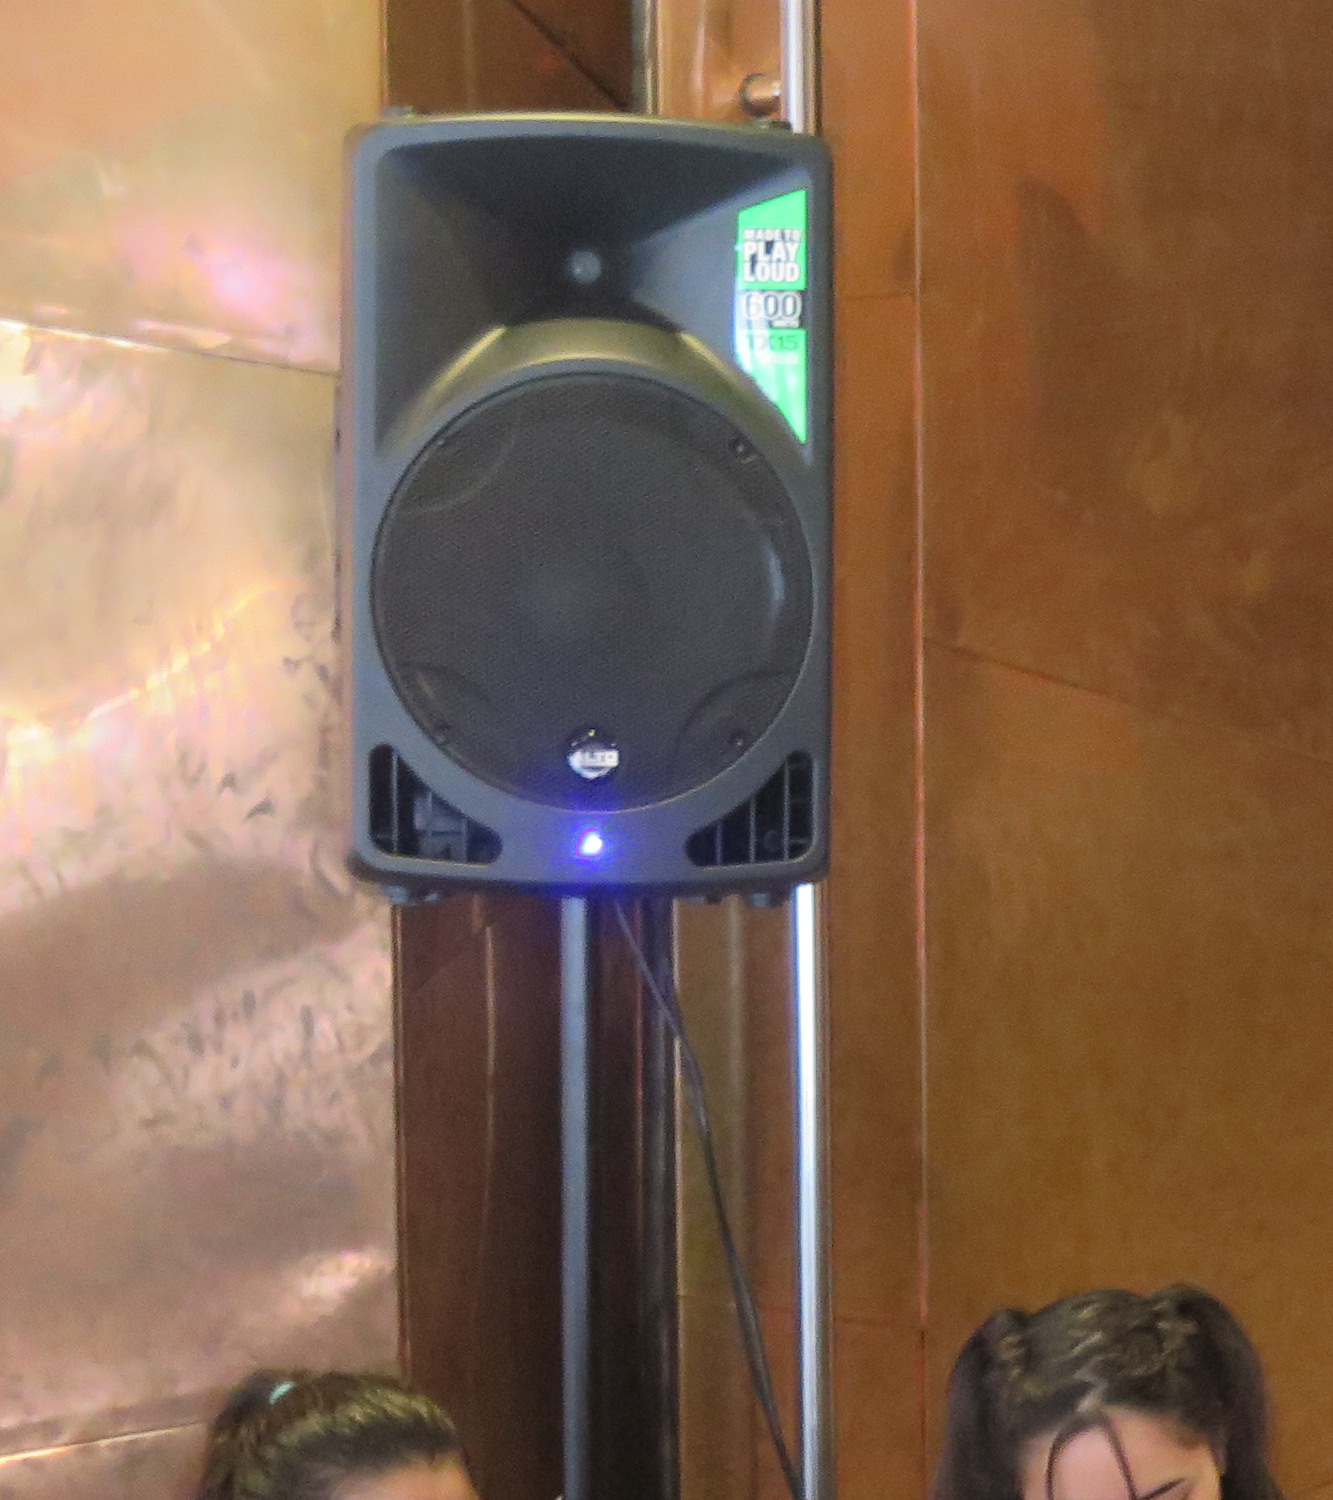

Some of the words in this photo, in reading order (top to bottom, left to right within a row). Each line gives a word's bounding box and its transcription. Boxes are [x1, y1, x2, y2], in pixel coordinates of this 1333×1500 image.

[743, 241, 800, 261] PLAY
[743, 262, 801, 282] LOUD
[741, 291, 801, 320] 600
